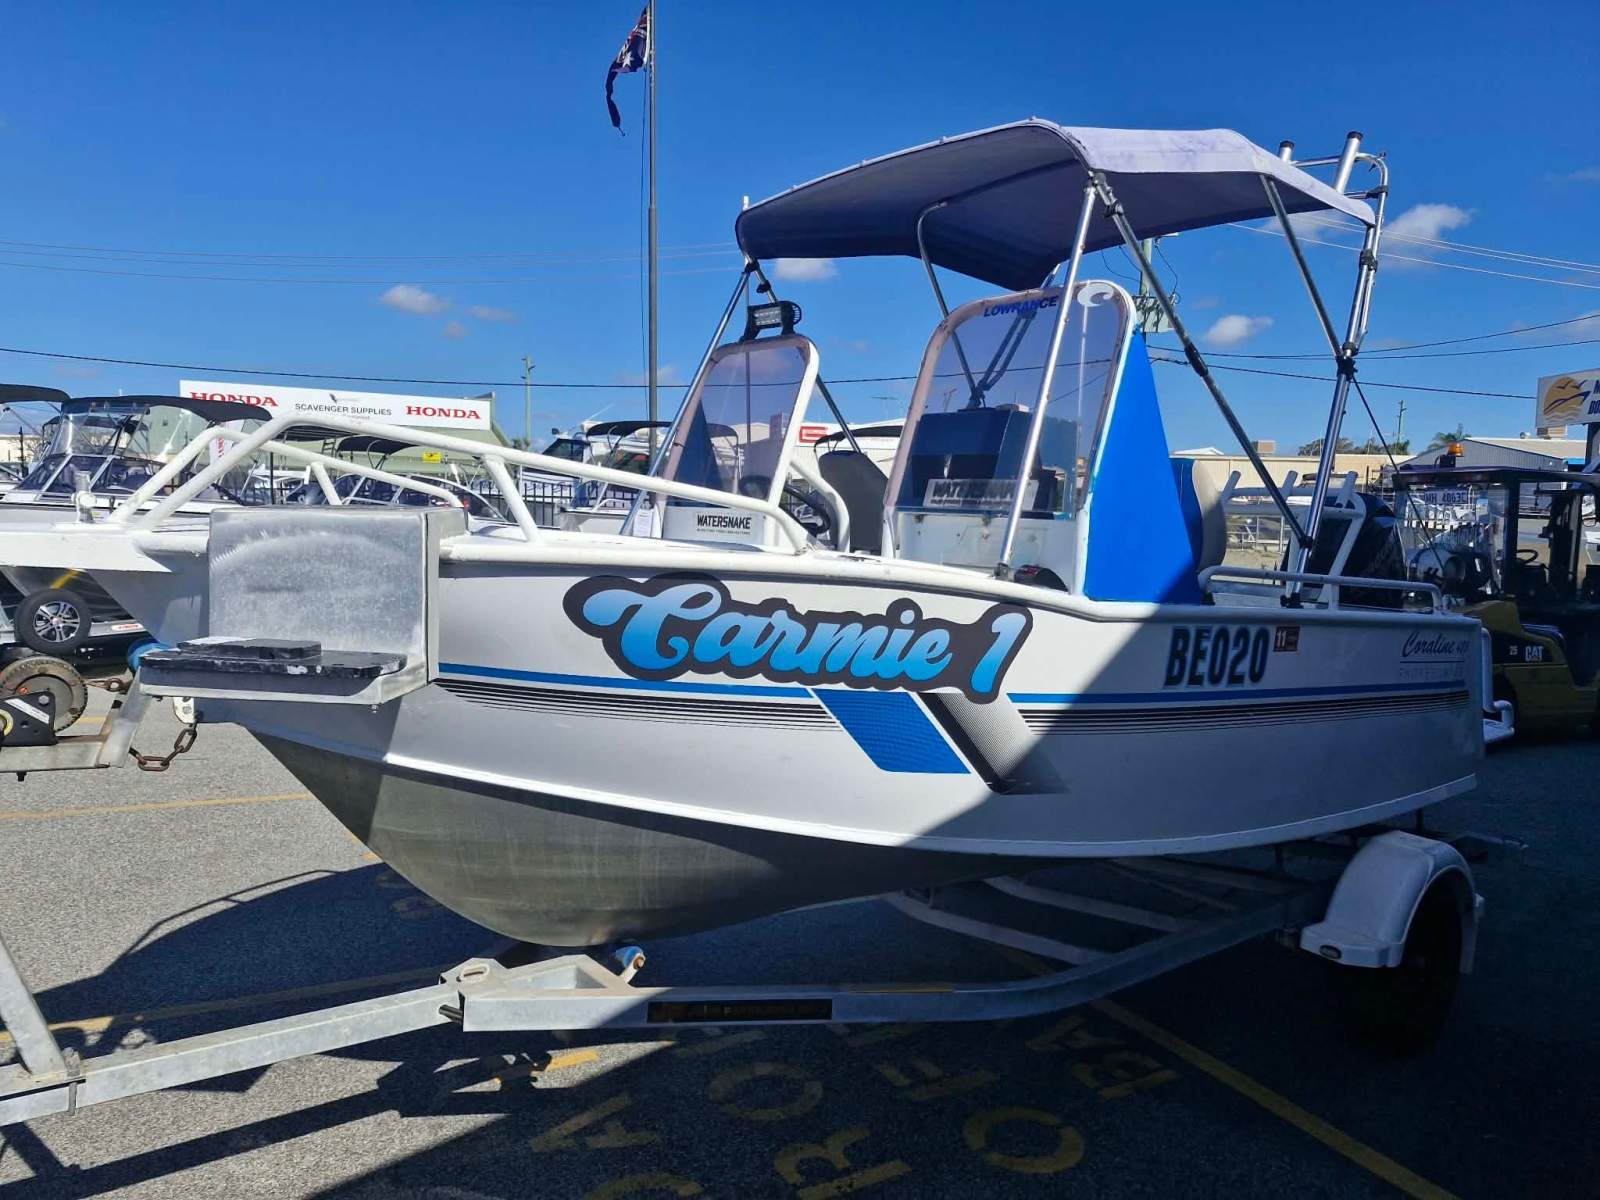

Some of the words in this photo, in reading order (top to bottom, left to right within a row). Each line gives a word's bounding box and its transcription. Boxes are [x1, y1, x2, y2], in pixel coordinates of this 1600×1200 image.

[983, 296, 1059, 318] LOWRANCE
[189, 391, 279, 407] HONDA
[295, 403, 349, 413] SCAVENGER
[351, 406, 393, 416] SUPPLIES
[406, 405, 482, 420] HONDA
[696, 514, 753, 530] WATERSNAKE
[581, 582, 954, 682] Carmie
[969, 611, 1027, 694] 1
[1401, 631, 1455, 658] Coraline
[1164, 625, 1270, 687] BE020
[1524, 644, 1545, 662] CAT
